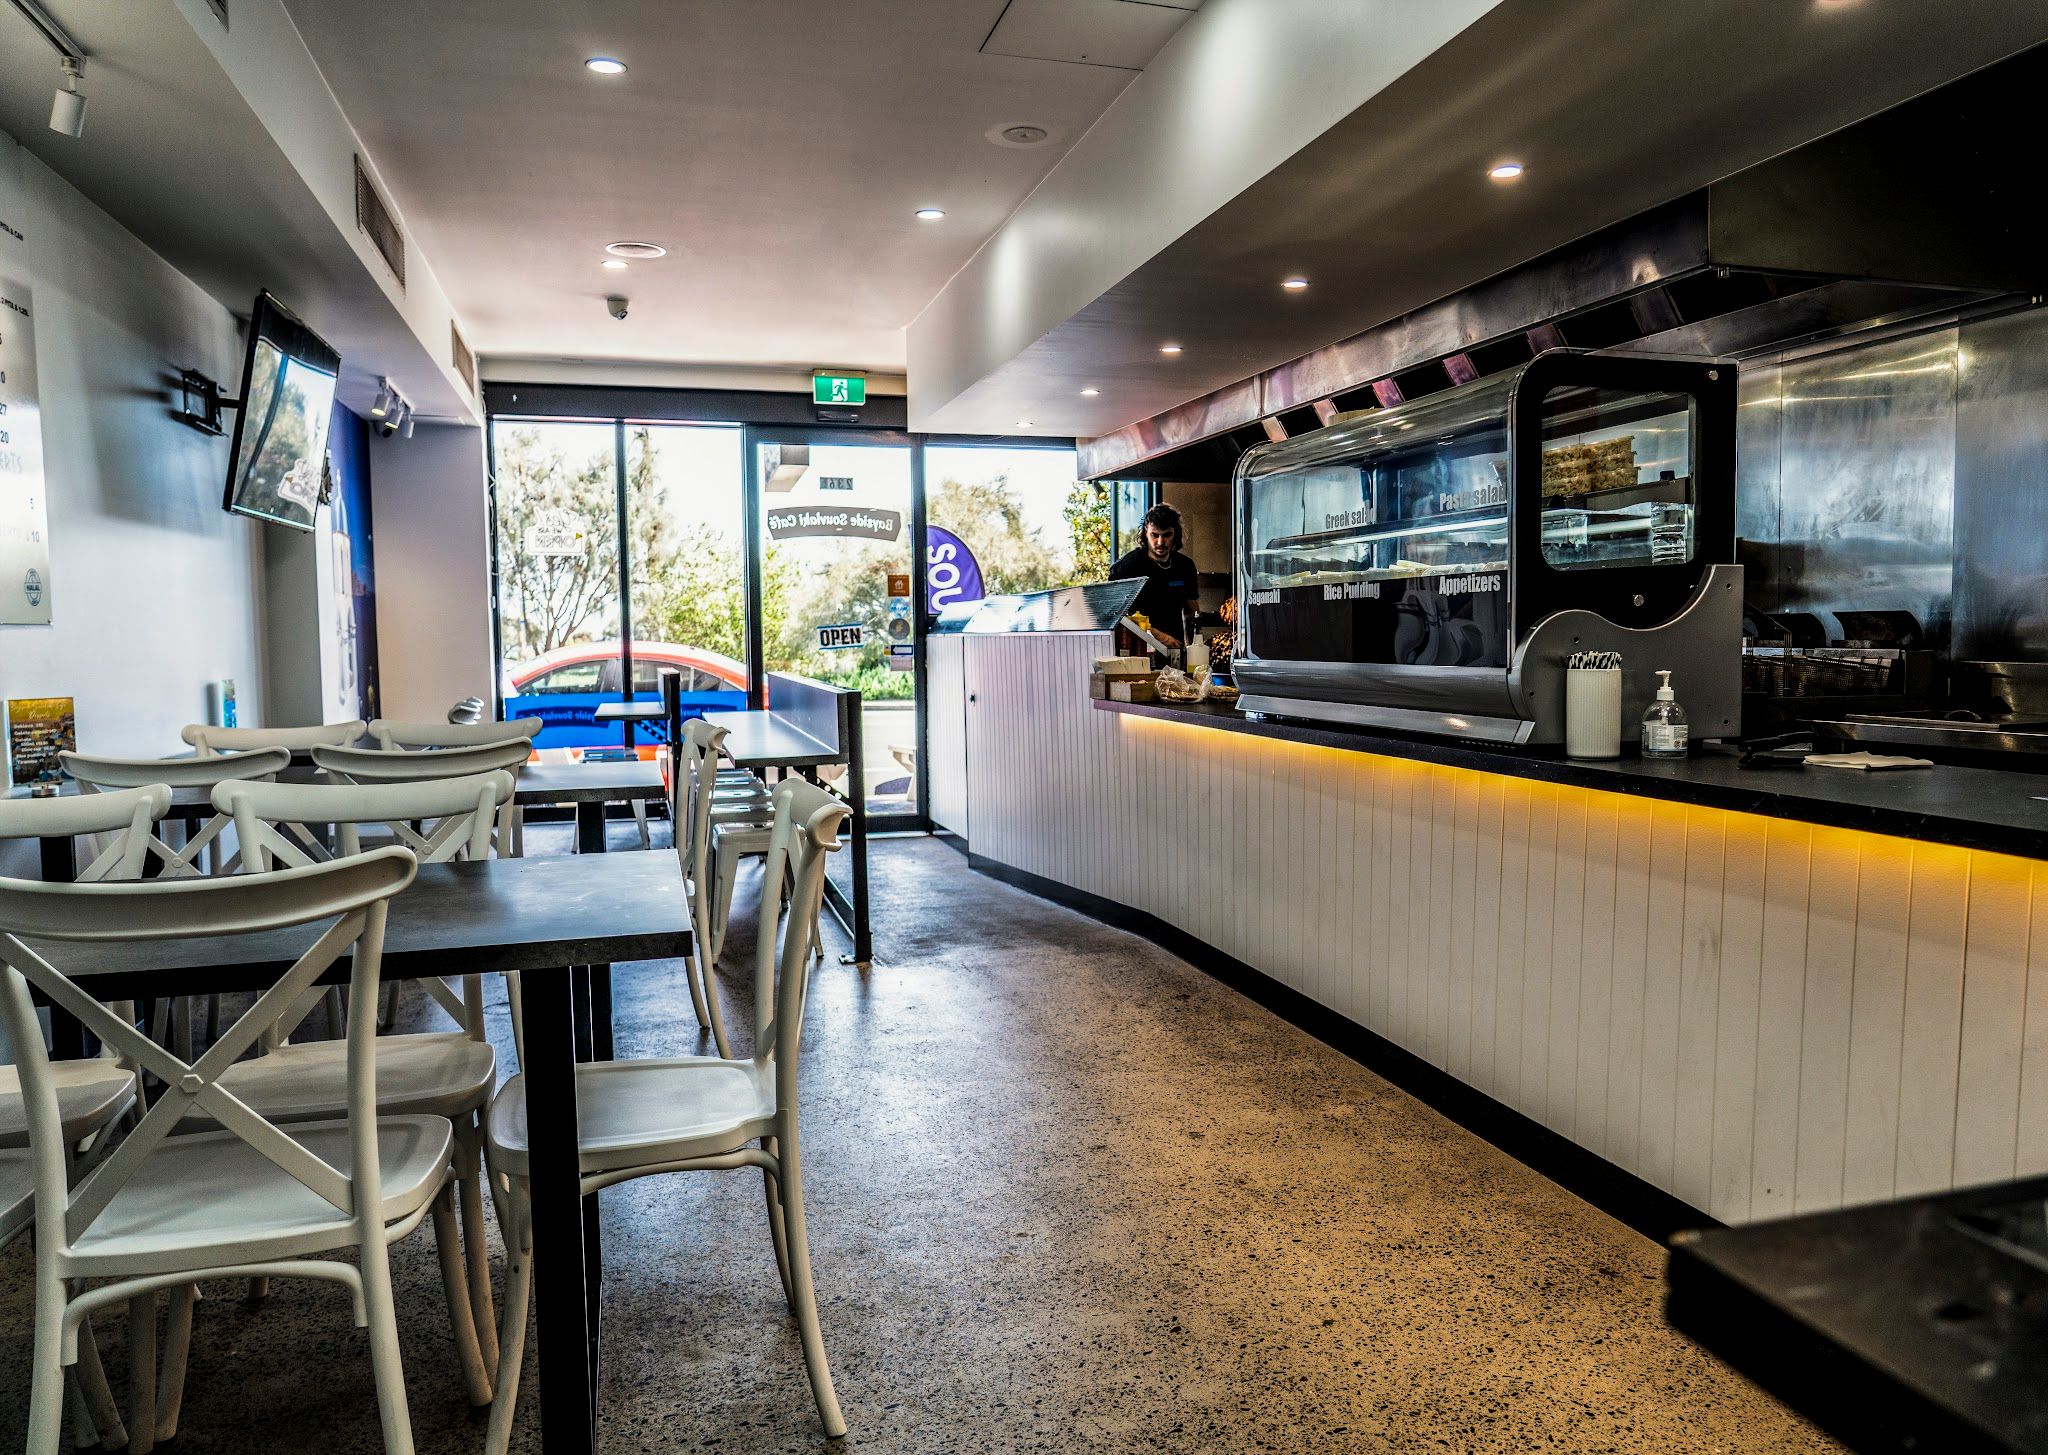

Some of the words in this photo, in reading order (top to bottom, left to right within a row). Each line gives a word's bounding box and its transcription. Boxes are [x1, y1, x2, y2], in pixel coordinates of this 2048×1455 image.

[1439, 491, 1471, 512] Pasta
[1325, 510, 1350, 530] Greek
[1323, 583, 1343, 600] Rice
[1343, 581, 1380, 600] Pudding
[1438, 573, 1501, 596] Appetizers
[1248, 589, 1281, 606] Saganaki
[820, 627, 862, 647] OPEN
